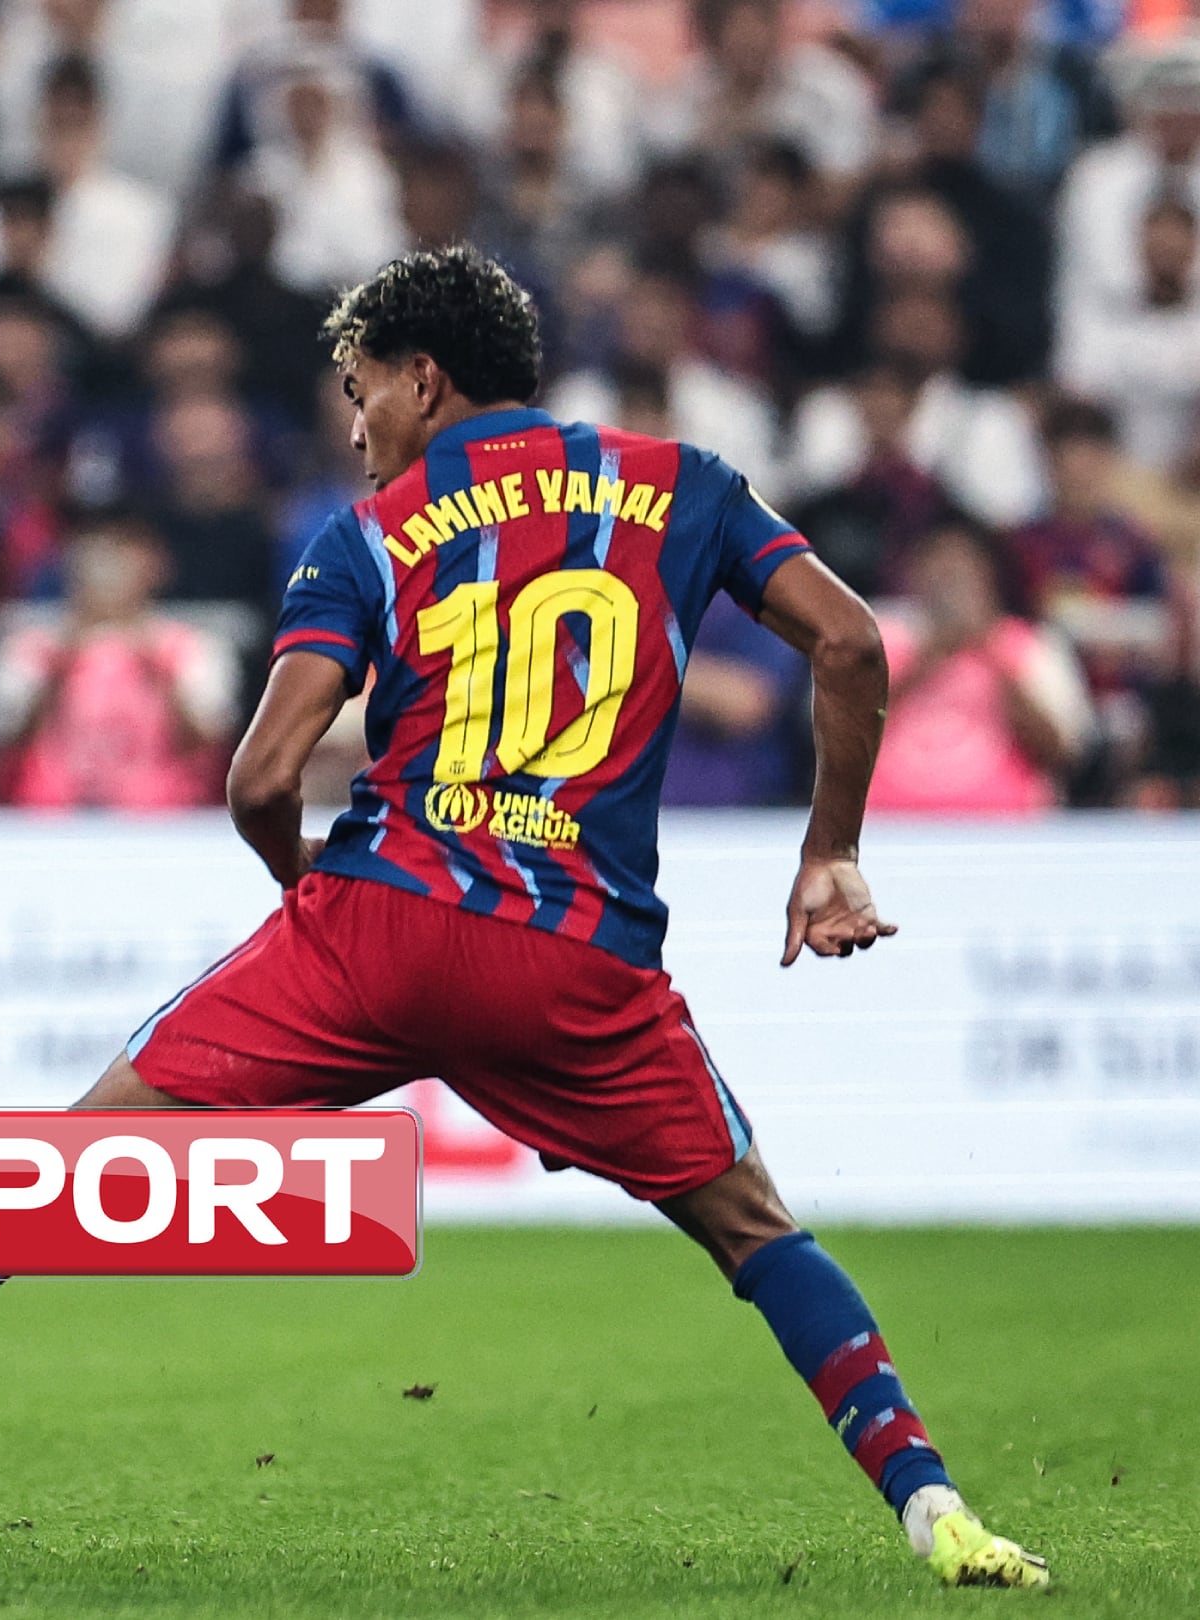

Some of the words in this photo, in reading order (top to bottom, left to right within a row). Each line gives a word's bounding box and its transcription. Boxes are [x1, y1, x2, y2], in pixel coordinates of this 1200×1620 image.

[383, 472, 530, 568] LAMINE
[535, 468, 673, 532] YAMAL
[416, 568, 639, 783] 10
[488, 811, 580, 842] ACNUR
